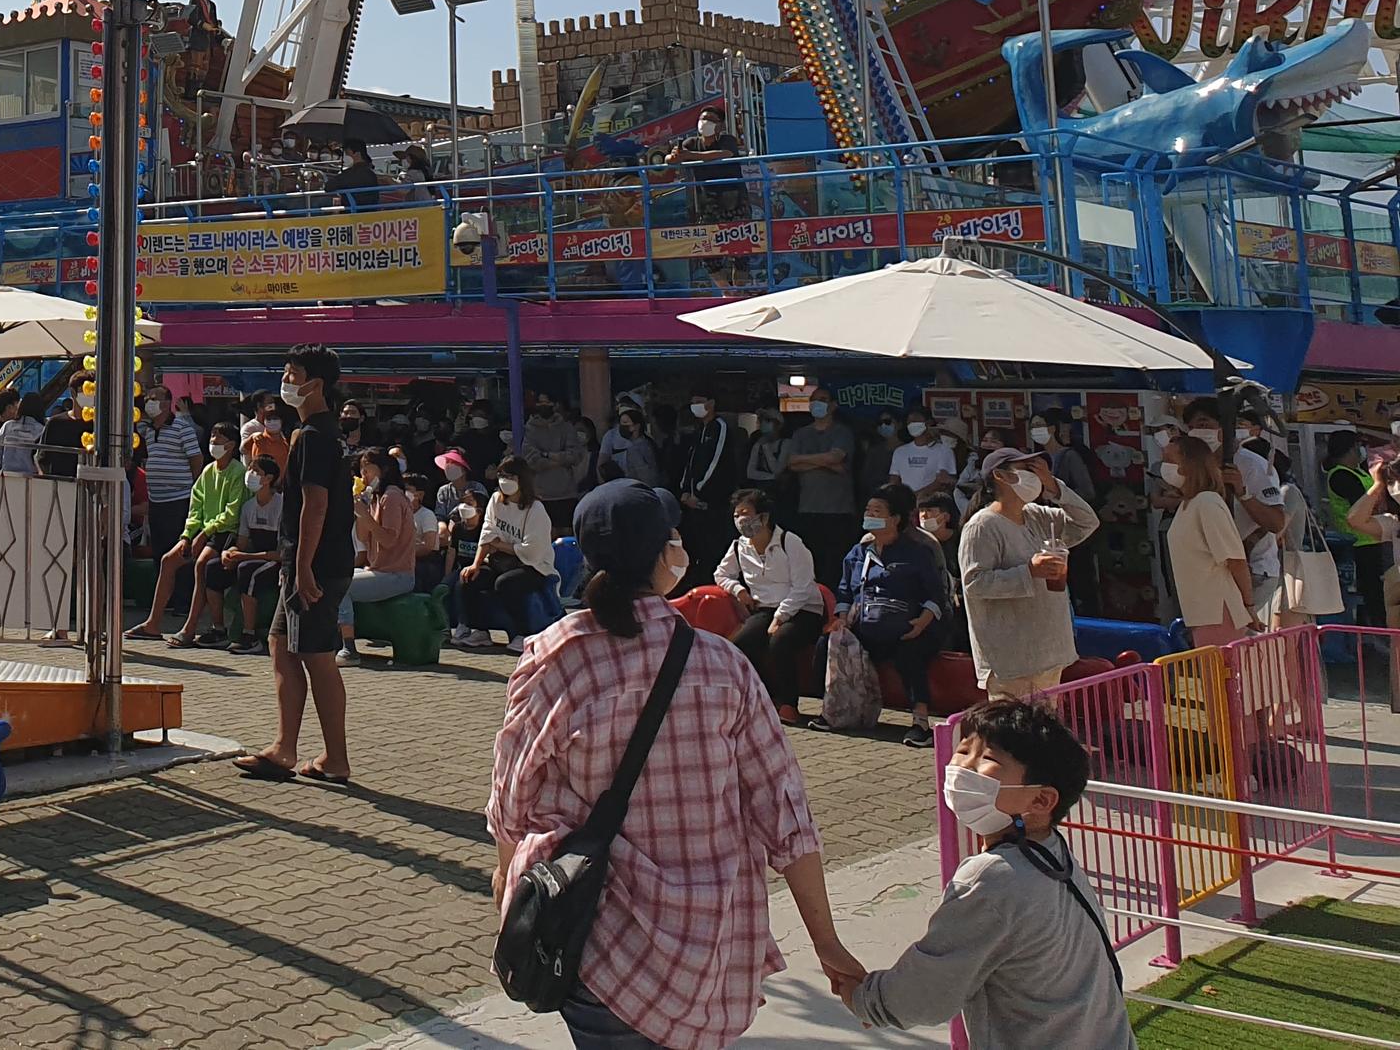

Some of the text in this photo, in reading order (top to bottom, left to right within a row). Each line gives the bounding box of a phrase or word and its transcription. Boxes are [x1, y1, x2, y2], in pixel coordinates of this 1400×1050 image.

[138, 219, 418, 254] 이랜드는 코로나바이러스 예방을 위해 놀이시설
[660, 228, 691, 240] 대한민국
[713, 222, 760, 246] 바이킹
[813, 218, 873, 245] 바이킹
[957, 208, 1023, 241] 바이킹
[580, 231, 633, 258] 바이킹
[155, 254, 190, 276] 소독을
[193, 256, 228, 276] 했으며
[231, 253, 245, 275] 손
[248, 251, 304, 275] 소독제가
[307, 246, 422, 273] 비치되어있습니다.
[267, 282, 299, 295] 마이랜드
[837, 382, 905, 408] 마이랜드
